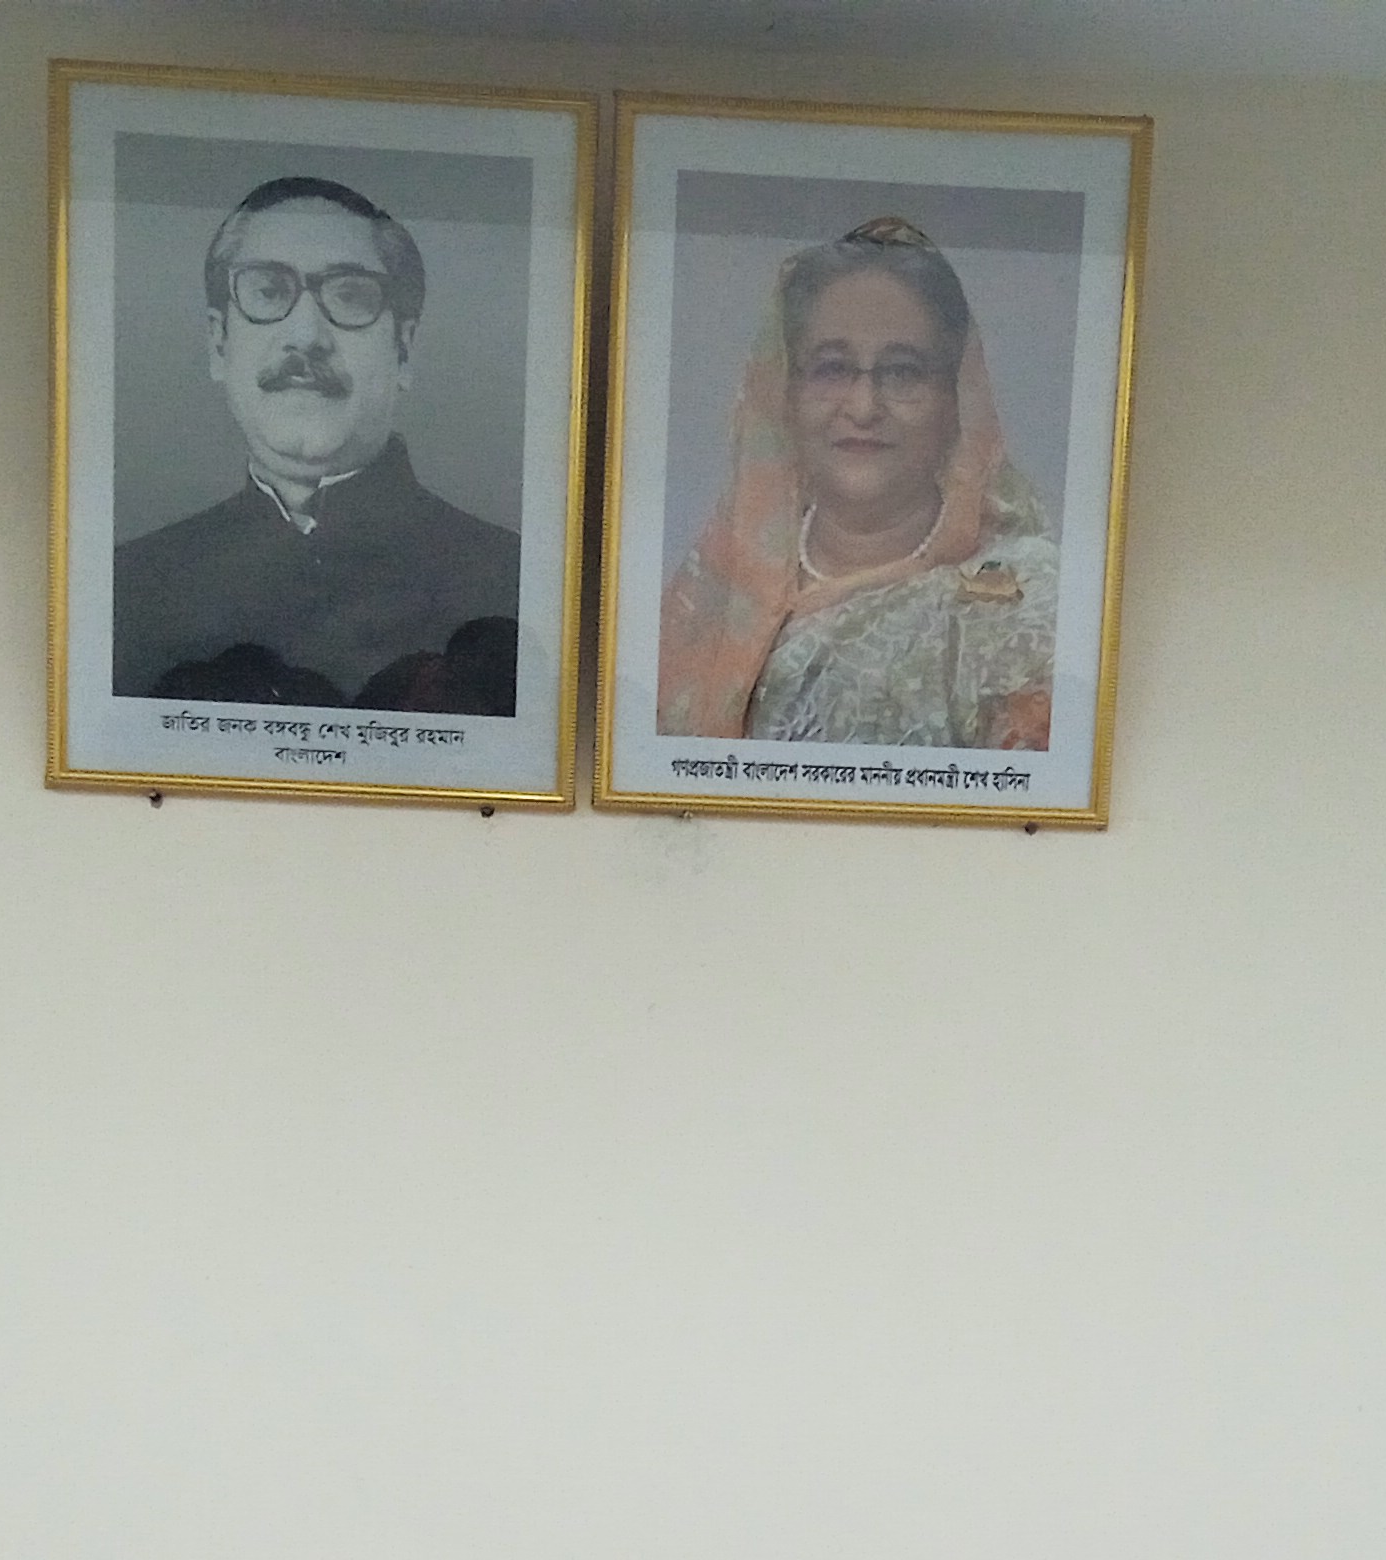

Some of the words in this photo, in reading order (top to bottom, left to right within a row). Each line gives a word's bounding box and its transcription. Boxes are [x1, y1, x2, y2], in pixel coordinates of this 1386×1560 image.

[319, 724, 350, 739] শেখ
[417, 729, 465, 744] রহমান
[274, 747, 347, 765] বাংলাদেশ
[743, 761, 798, 781] বাংলাদেশ
